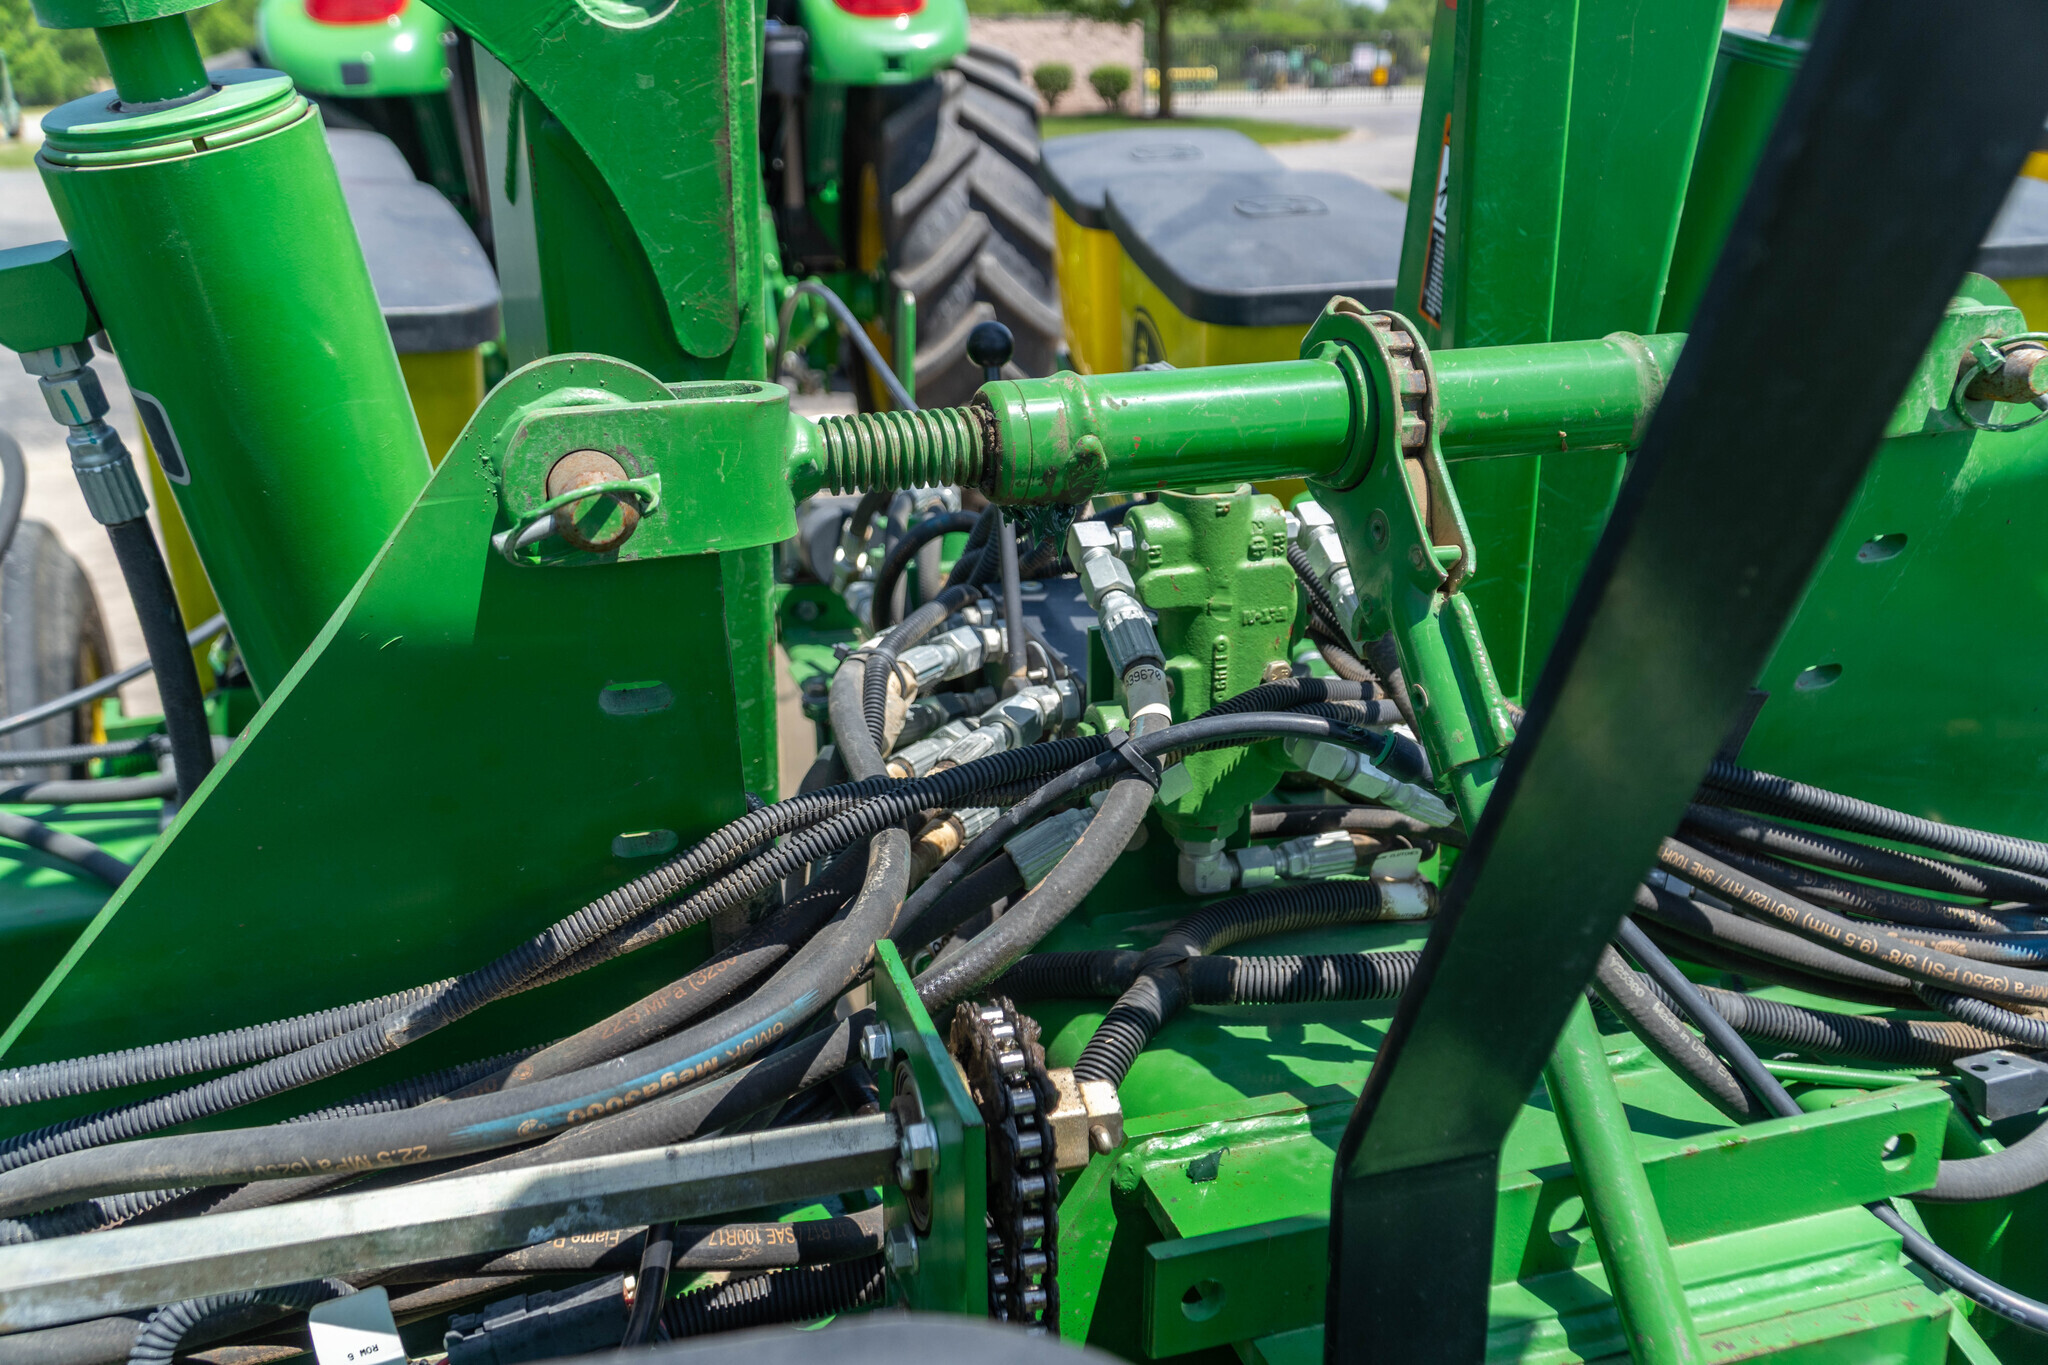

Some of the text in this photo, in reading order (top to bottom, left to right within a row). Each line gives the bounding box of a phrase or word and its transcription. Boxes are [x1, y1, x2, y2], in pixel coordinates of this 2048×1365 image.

[1690, 861, 1716, 883] SAE
[1720, 877, 1746, 897] R17
[1743, 889, 1799, 923] ISO11237
[1801, 912, 1842, 940] mm)
[1844, 932, 1878, 955] (9.5
[1921, 956, 1960, 981] PSI)
[1962, 970, 2010, 993] (3250
[1652, 1000, 1680, 1033] Made
[1679, 1031, 1691, 1044] in
[1691, 1040, 1714, 1066] USA
[708, 1228, 761, 1247] 100R17
[766, 1226, 796, 1245] SAE
[359, 1344, 379, 1357] ROW
